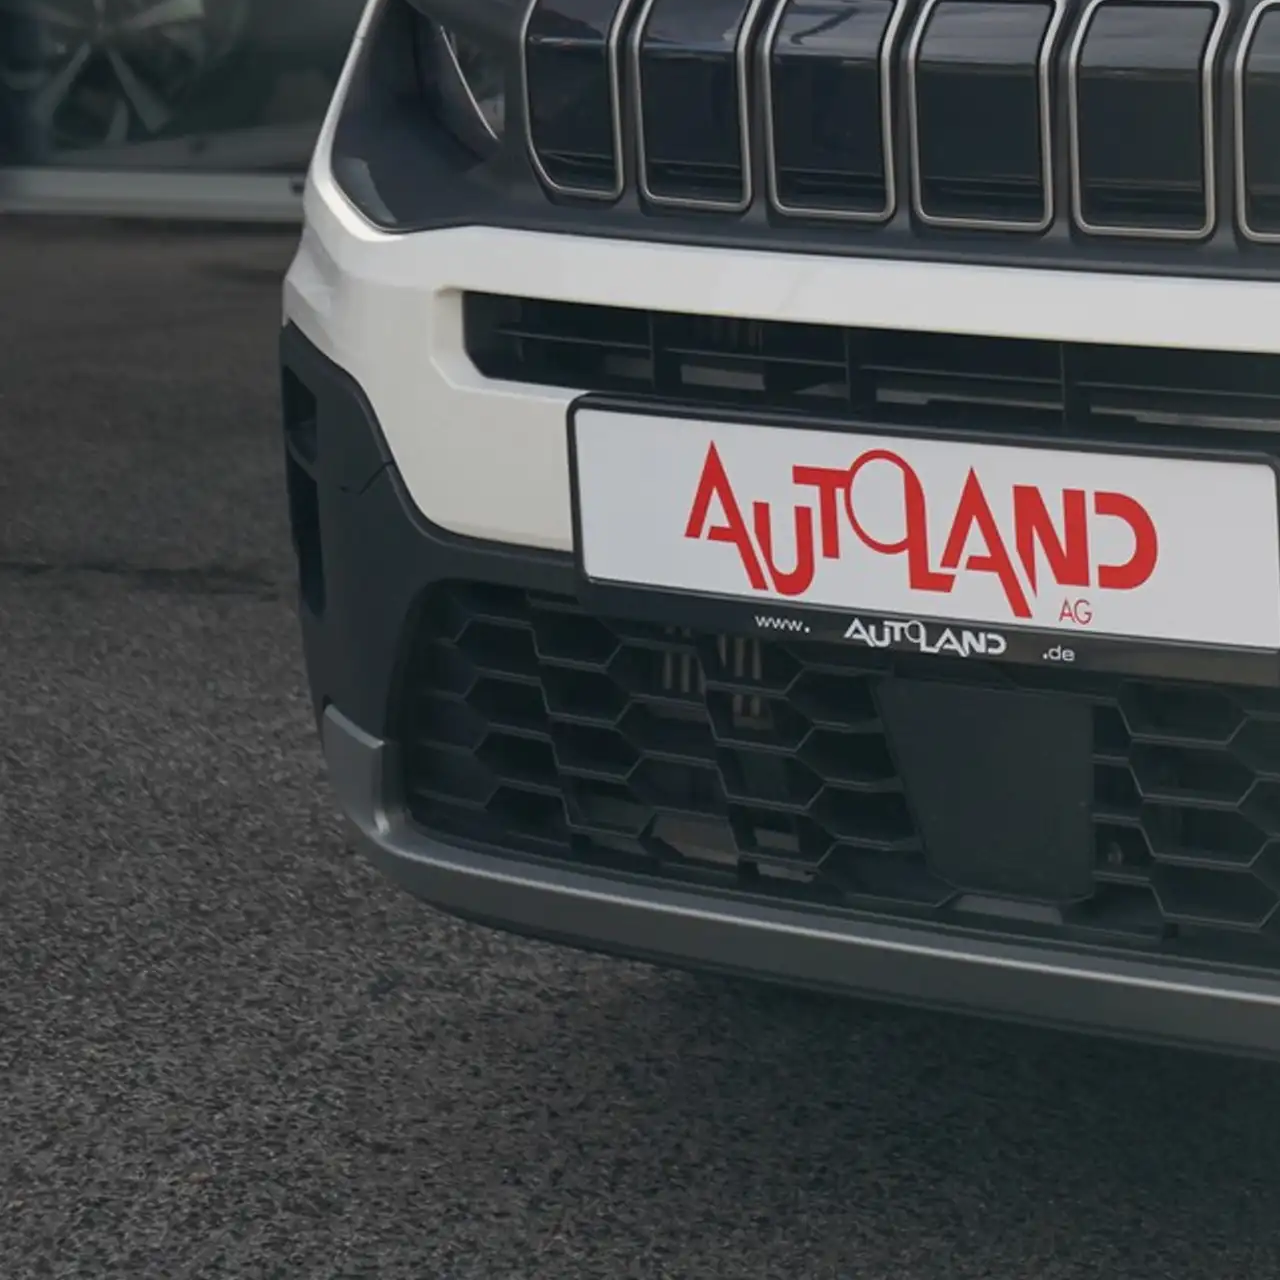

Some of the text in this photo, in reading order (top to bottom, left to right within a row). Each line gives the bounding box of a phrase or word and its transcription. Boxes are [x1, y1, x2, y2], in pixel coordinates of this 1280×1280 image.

[684, 439, 1159, 618] AUTOLAND
[1058, 597, 1093, 625] AG
[754, 614, 1076, 663] www. AUTOLAND .de
